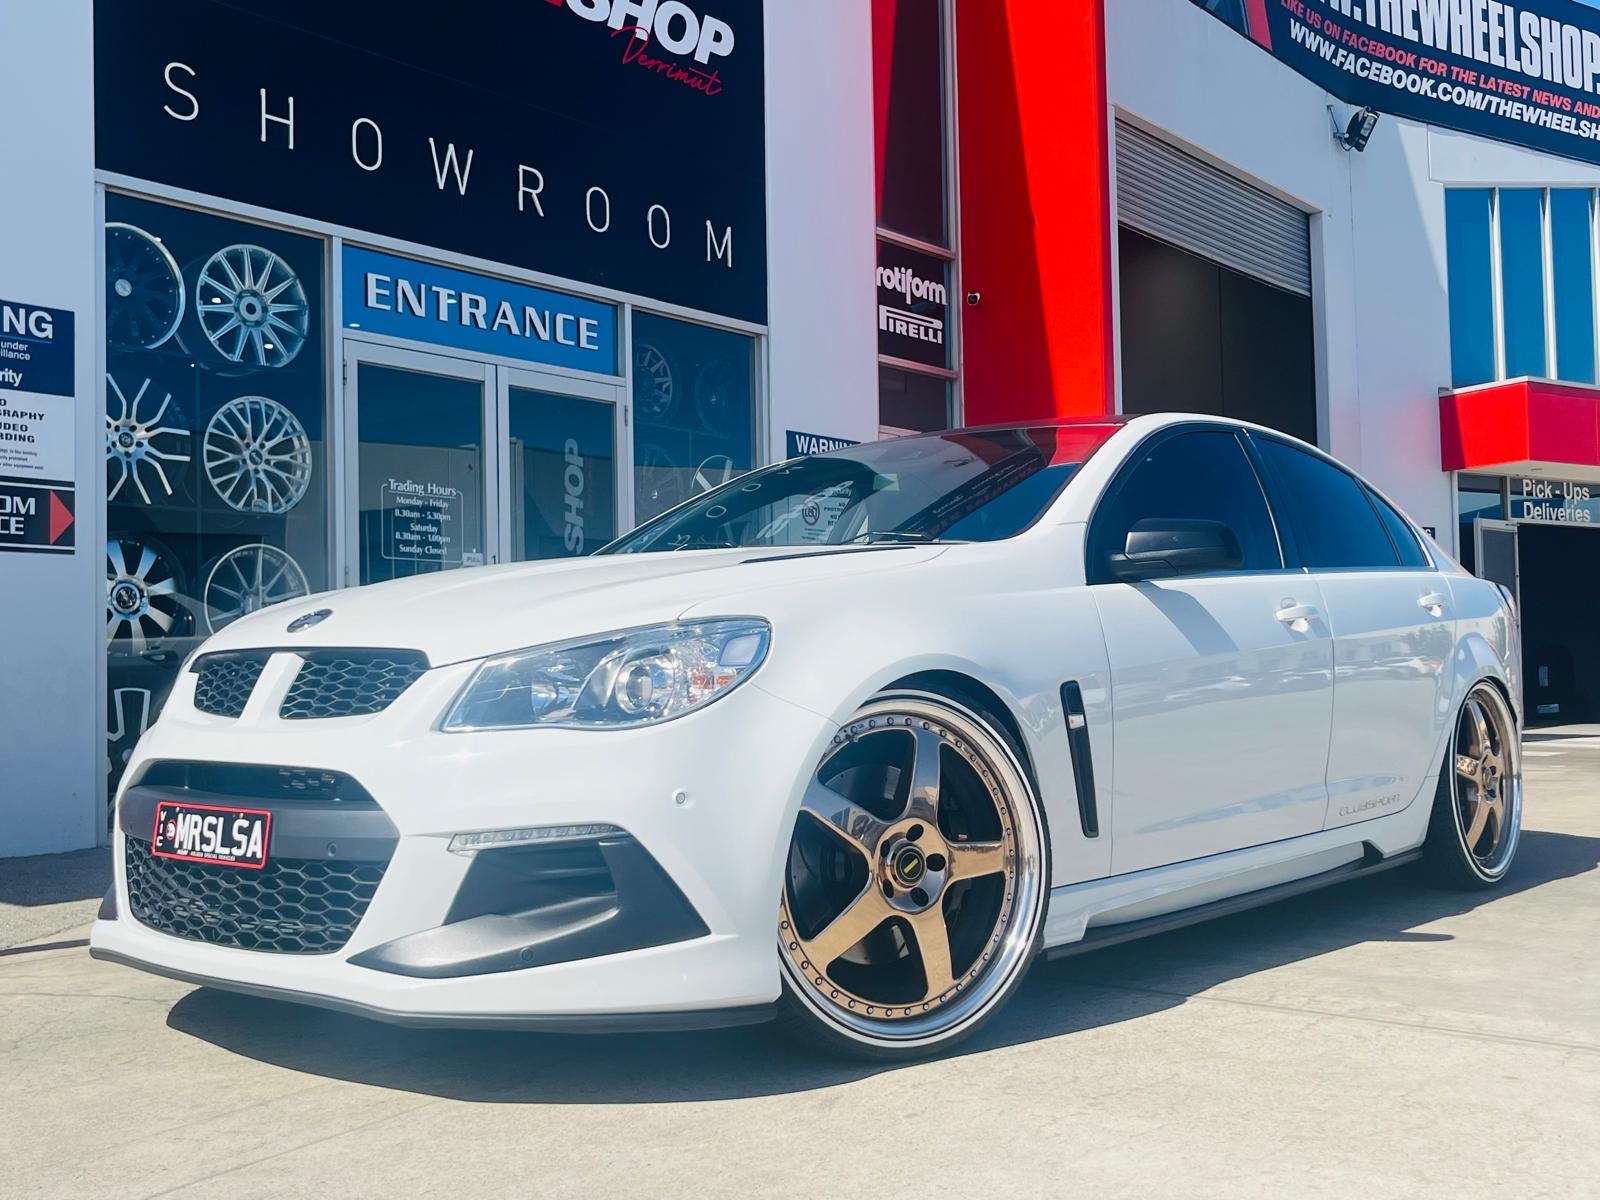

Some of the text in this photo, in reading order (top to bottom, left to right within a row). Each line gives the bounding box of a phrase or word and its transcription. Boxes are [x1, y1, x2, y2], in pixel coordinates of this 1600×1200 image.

[610, 26, 722, 96] Verrimut
[1306, 8, 1322, 29] US
[1323, 19, 1341, 40] ON
[1342, 29, 1418, 68] FACEBOOK
[1418, 57, 1448, 77] FOR
[1450, 66, 1478, 85] THE
[1479, 74, 1531, 99] LATEST
[1532, 88, 1572, 112] NEWS
[1573, 101, 1600, 119] AND
[1290, 18, 1600, 141] WWW.FACEBOOK.COM/THEWHEELSH
[163, 62, 733, 268] SHOWROOM
[876, 266, 948, 305] rotiform
[2, 305, 53, 339] NG
[365, 272, 599, 350] ENTRANCE
[878, 304, 943, 344] PIRELLI
[0, 341, 28, 352] under
[0, 408, 45, 421] RAPHY
[388, 479, 456, 496] Trading Hours
[396, 496, 423, 508] Monday
[429, 499, 449, 509] Friday
[564, 438, 584, 555] SHOP
[1522, 479, 1552, 499] Pick
[1563, 482, 1590, 505] Ups
[410, 522, 439, 534] Saturday
[1523, 501, 1591, 522] Deliveries
[399, 544, 448, 555] Sunday Closed
[174, 812, 263, 859] MRSLSA
